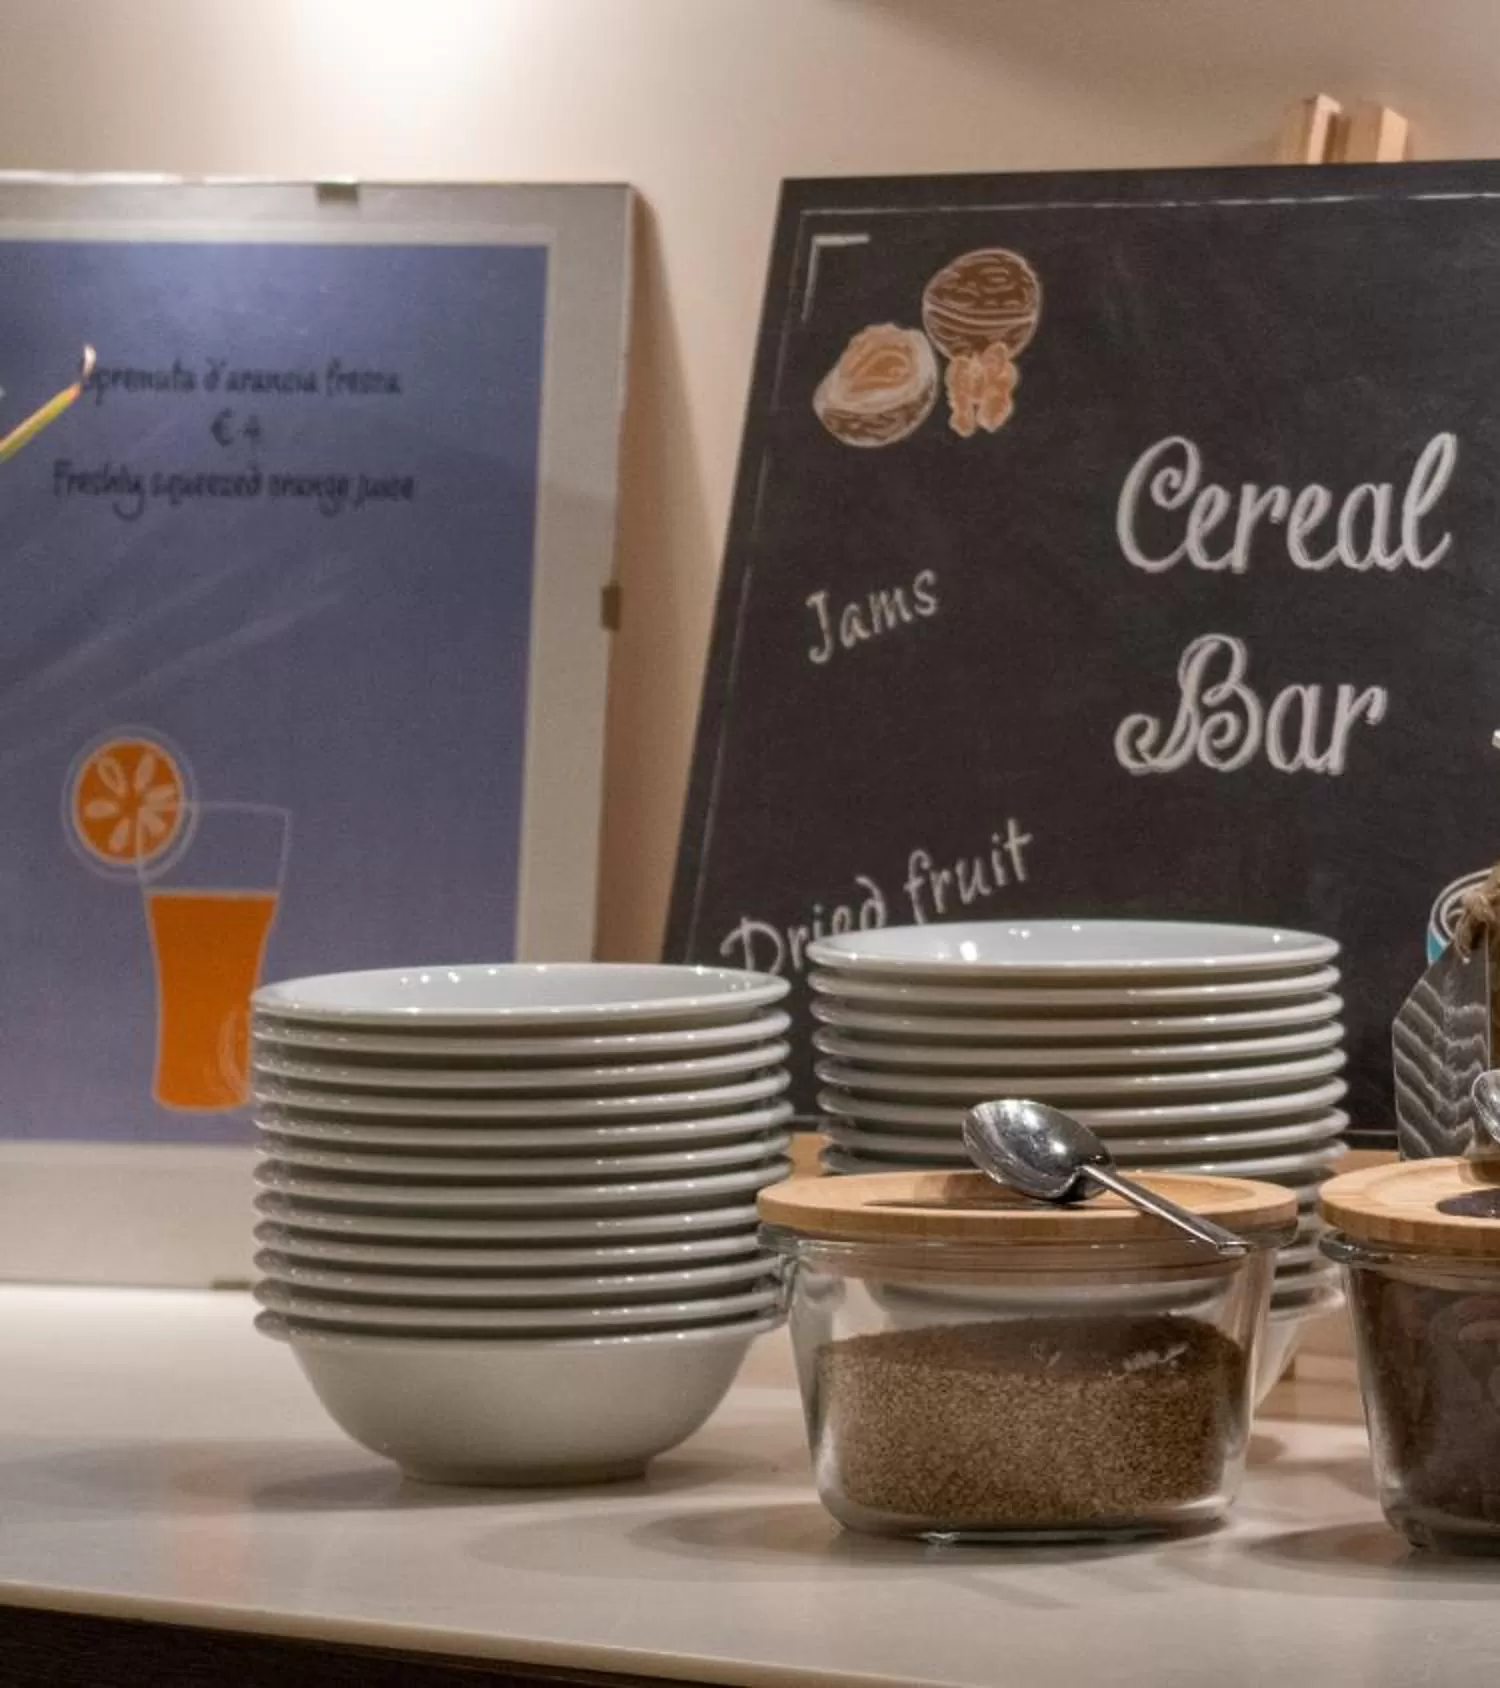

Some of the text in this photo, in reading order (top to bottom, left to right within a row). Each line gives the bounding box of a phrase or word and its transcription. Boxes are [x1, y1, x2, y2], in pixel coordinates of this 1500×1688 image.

[1116, 431, 1457, 575] Cereal
[805, 569, 938, 665] Jams
[1113, 633, 1388, 776] Bar
[904, 817, 1034, 925] fruit
